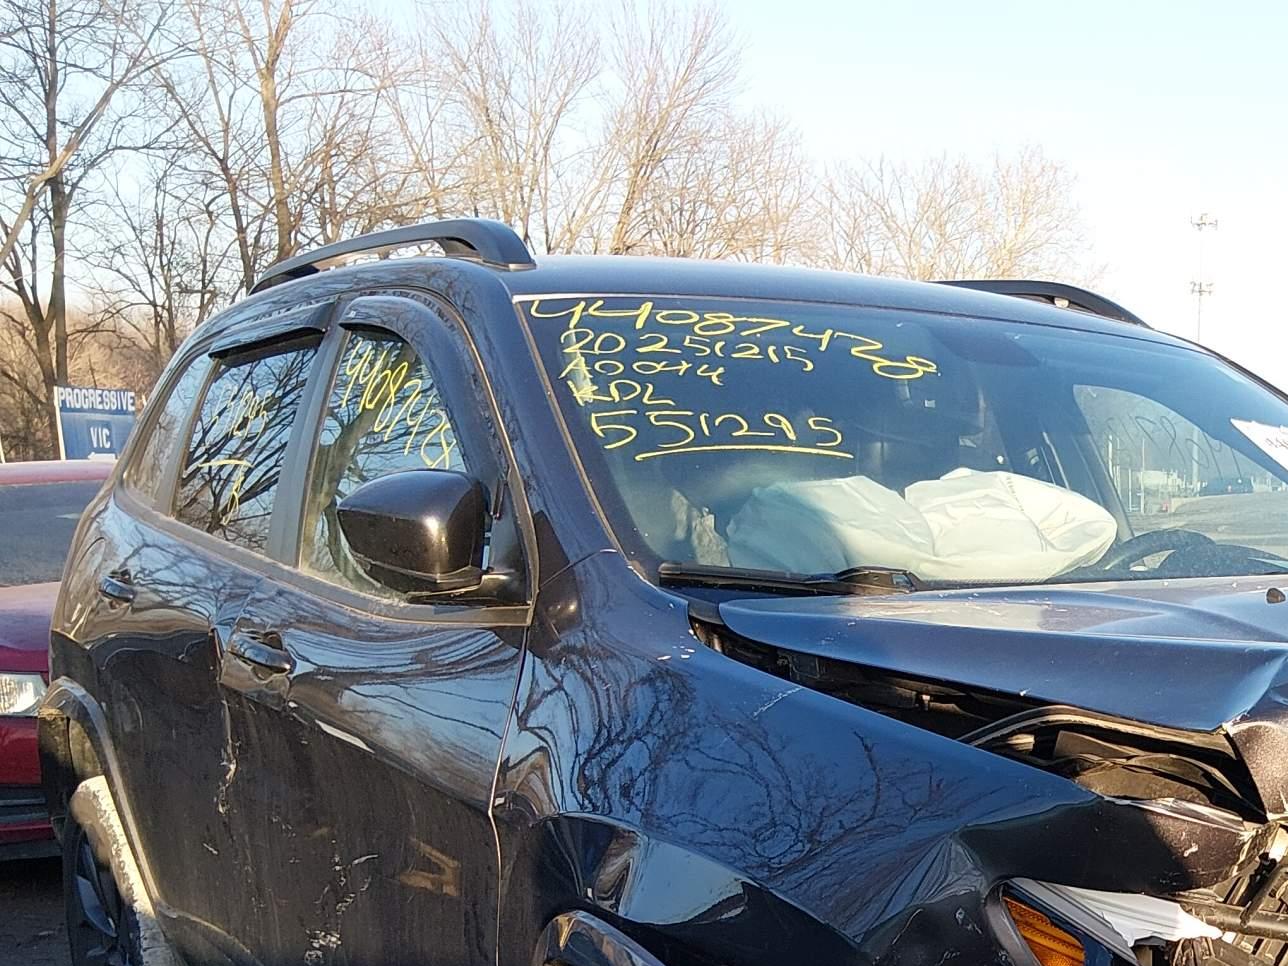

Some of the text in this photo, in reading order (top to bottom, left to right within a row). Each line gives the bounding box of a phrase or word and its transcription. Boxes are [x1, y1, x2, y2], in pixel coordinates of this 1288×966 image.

[529, 300, 938, 379] 44087428
[58, 387, 136, 411] PROGRESSIVE
[341, 339, 457, 470] 44087428
[90, 427, 111, 449] VIC
[591, 409, 843, 450] 551295
